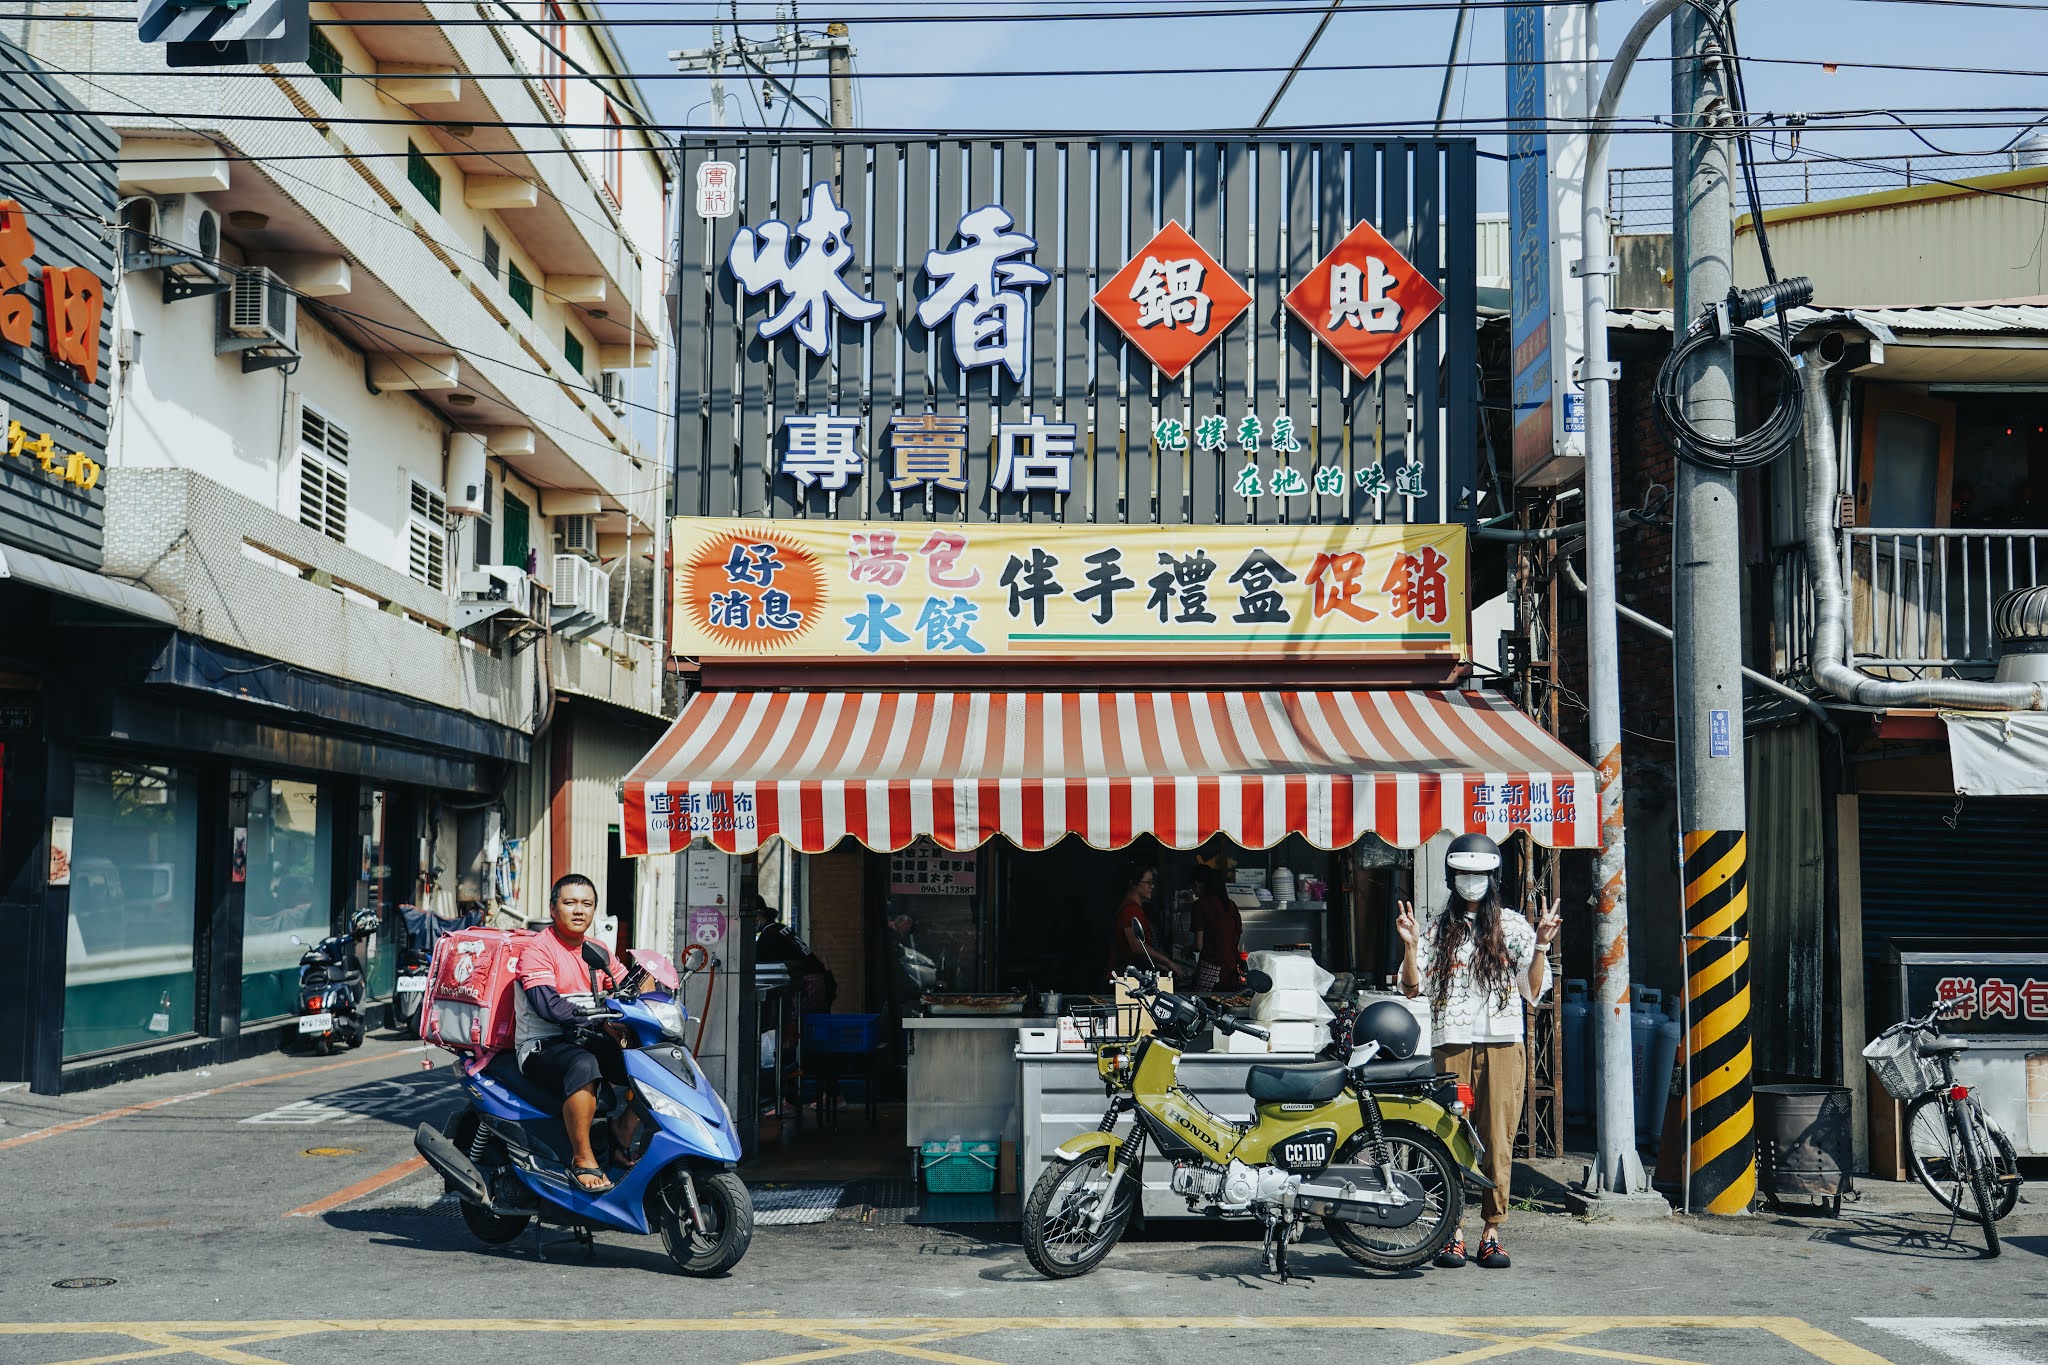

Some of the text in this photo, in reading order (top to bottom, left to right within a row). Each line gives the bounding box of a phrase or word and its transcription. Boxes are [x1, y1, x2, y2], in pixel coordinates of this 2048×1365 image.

[728, 181, 1052, 383] 味香
[781, 412, 1077, 492] 專賣店
[1155, 414, 1301, 452] 純樸香氣
[1234, 463, 1428, 497] 在地的味道
[725, 544, 783, 587] 好
[848, 531, 981, 587] 湯包
[709, 589, 802, 630] 消息
[845, 594, 986, 653] 水餃
[650, 792, 753, 814] 宜新帆布
[1472, 783, 1575, 806] 宜新帆布
[921, 885, 975, 894] 0963-172887
[1937, 977, 2048, 1020] 鮮肉包
[1168, 1109, 1220, 1153] HONDA
